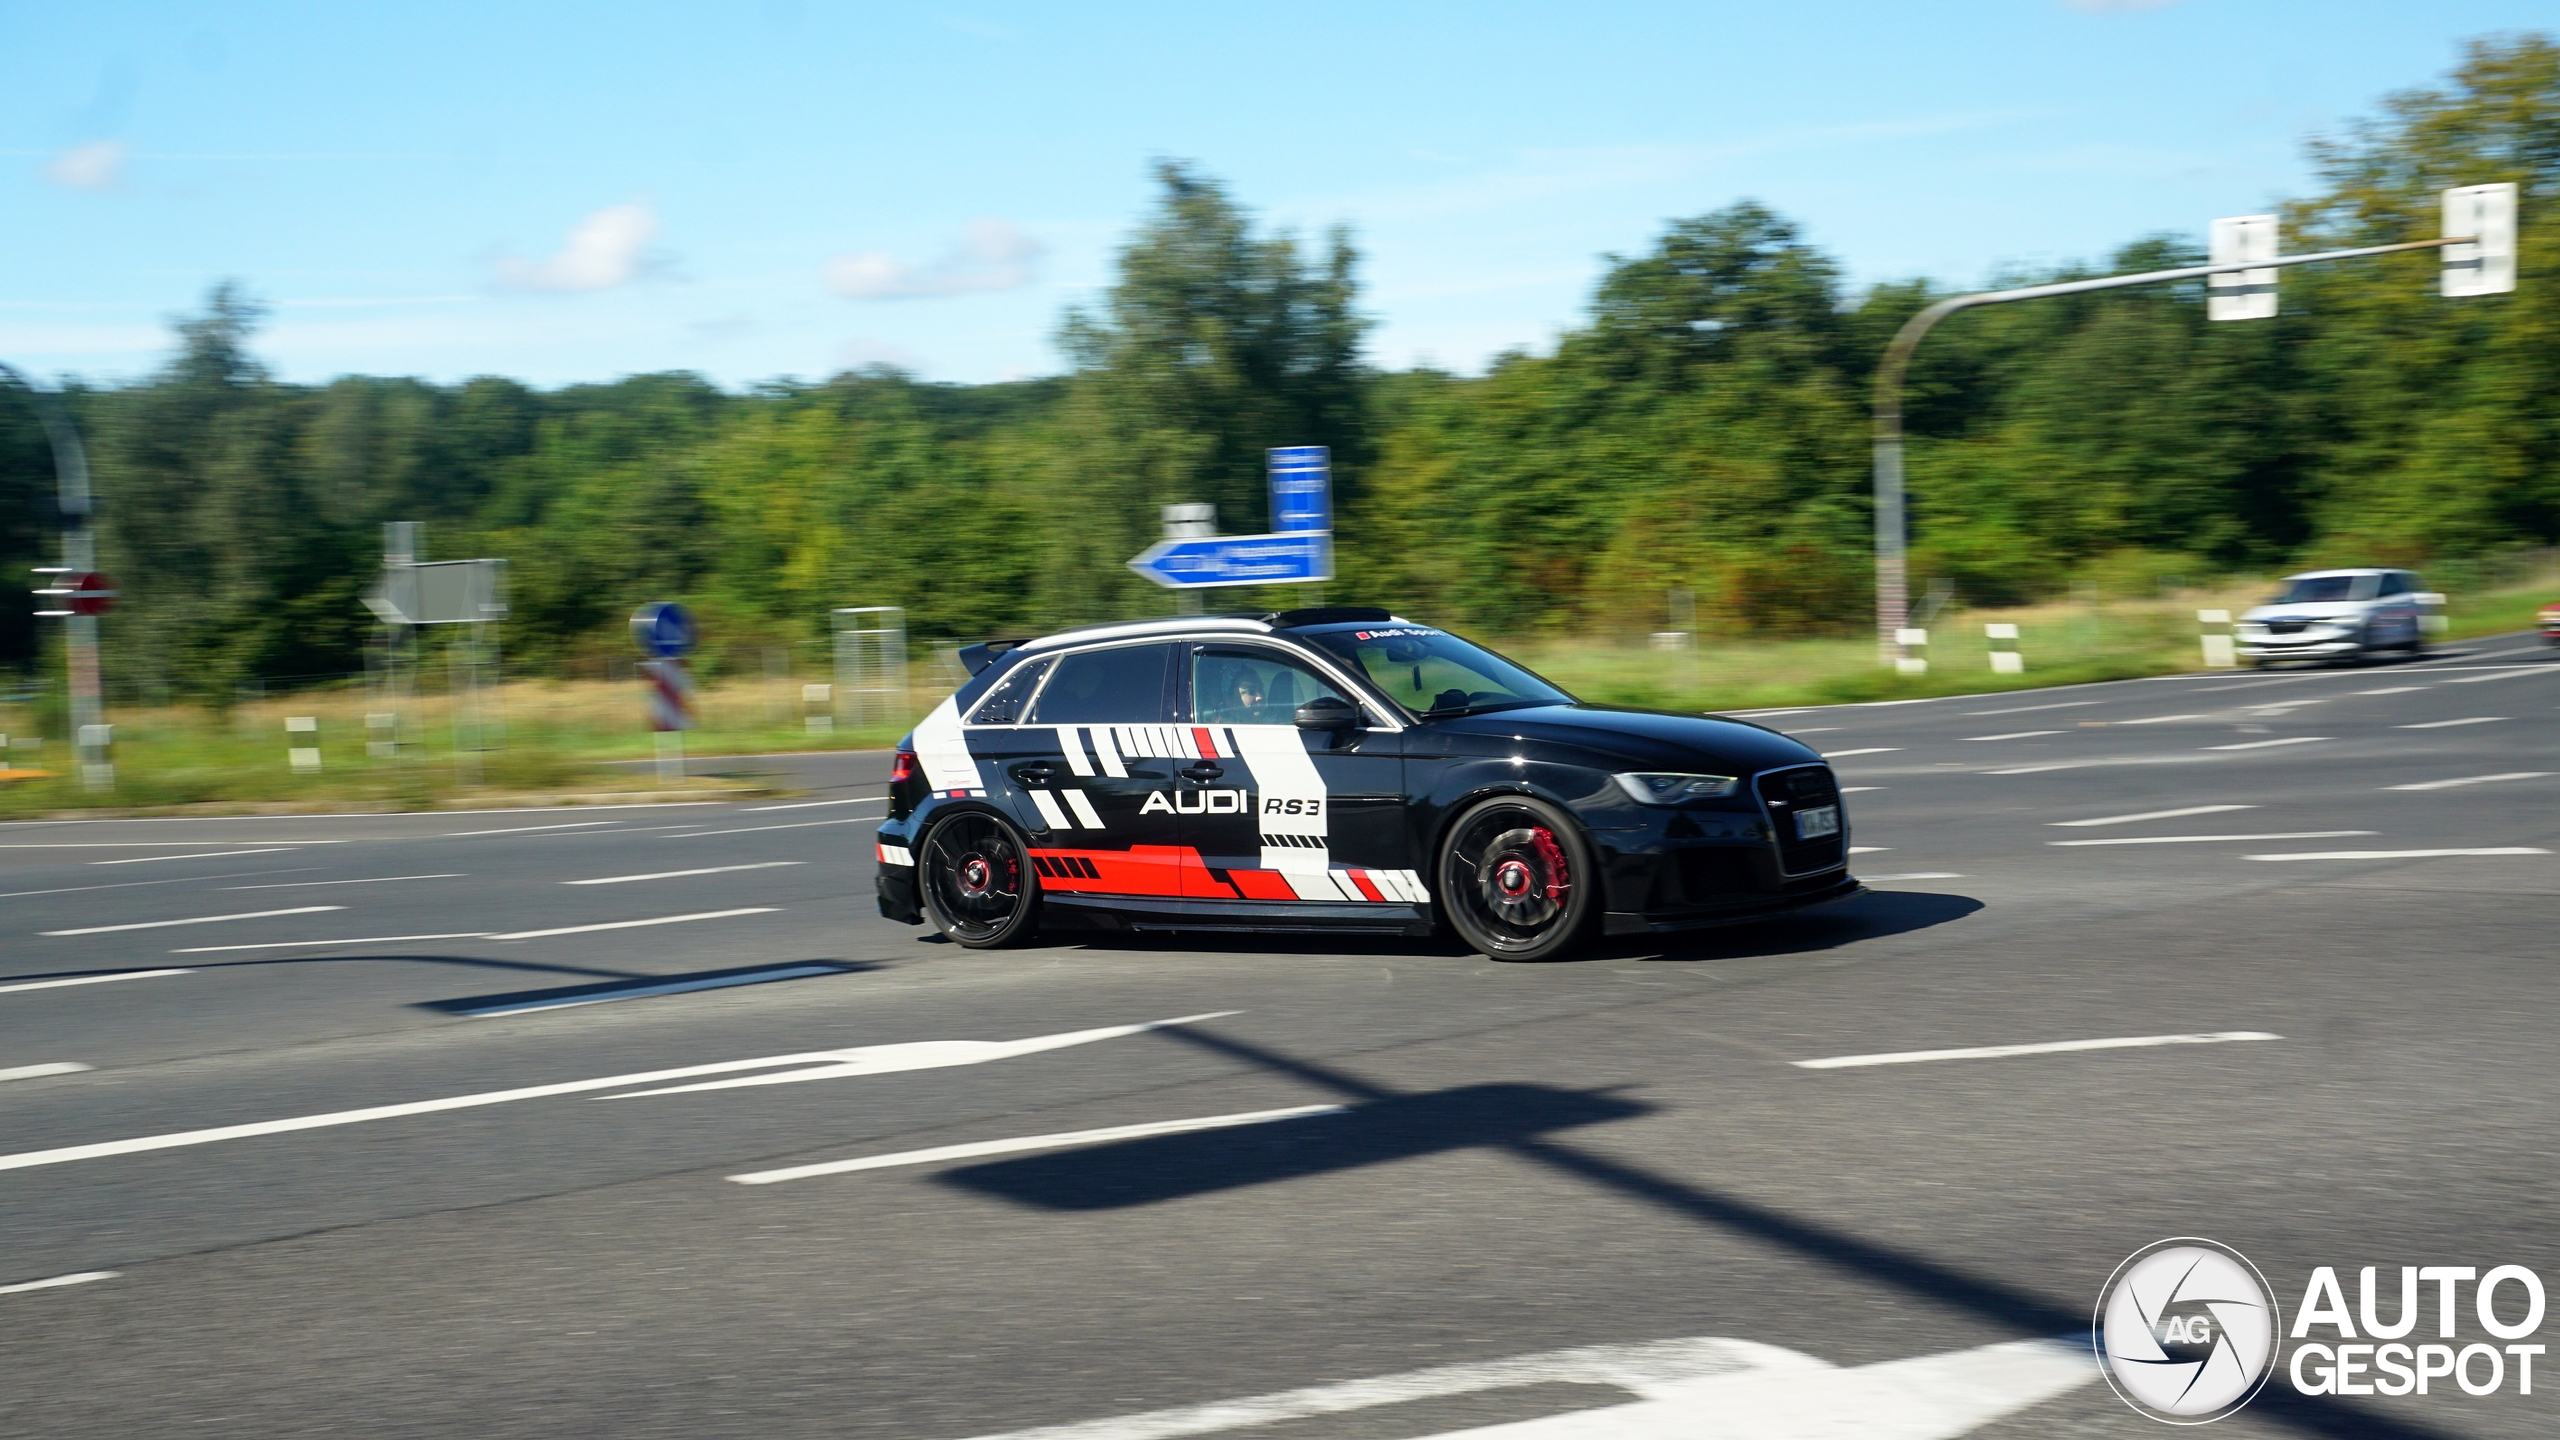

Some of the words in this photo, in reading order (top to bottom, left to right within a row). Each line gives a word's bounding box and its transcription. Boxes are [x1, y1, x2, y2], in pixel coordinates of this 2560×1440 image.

[1369, 629, 1405, 638] Audi
[1139, 790, 1248, 815] AUDI
[1264, 798, 1320, 816] RS3
